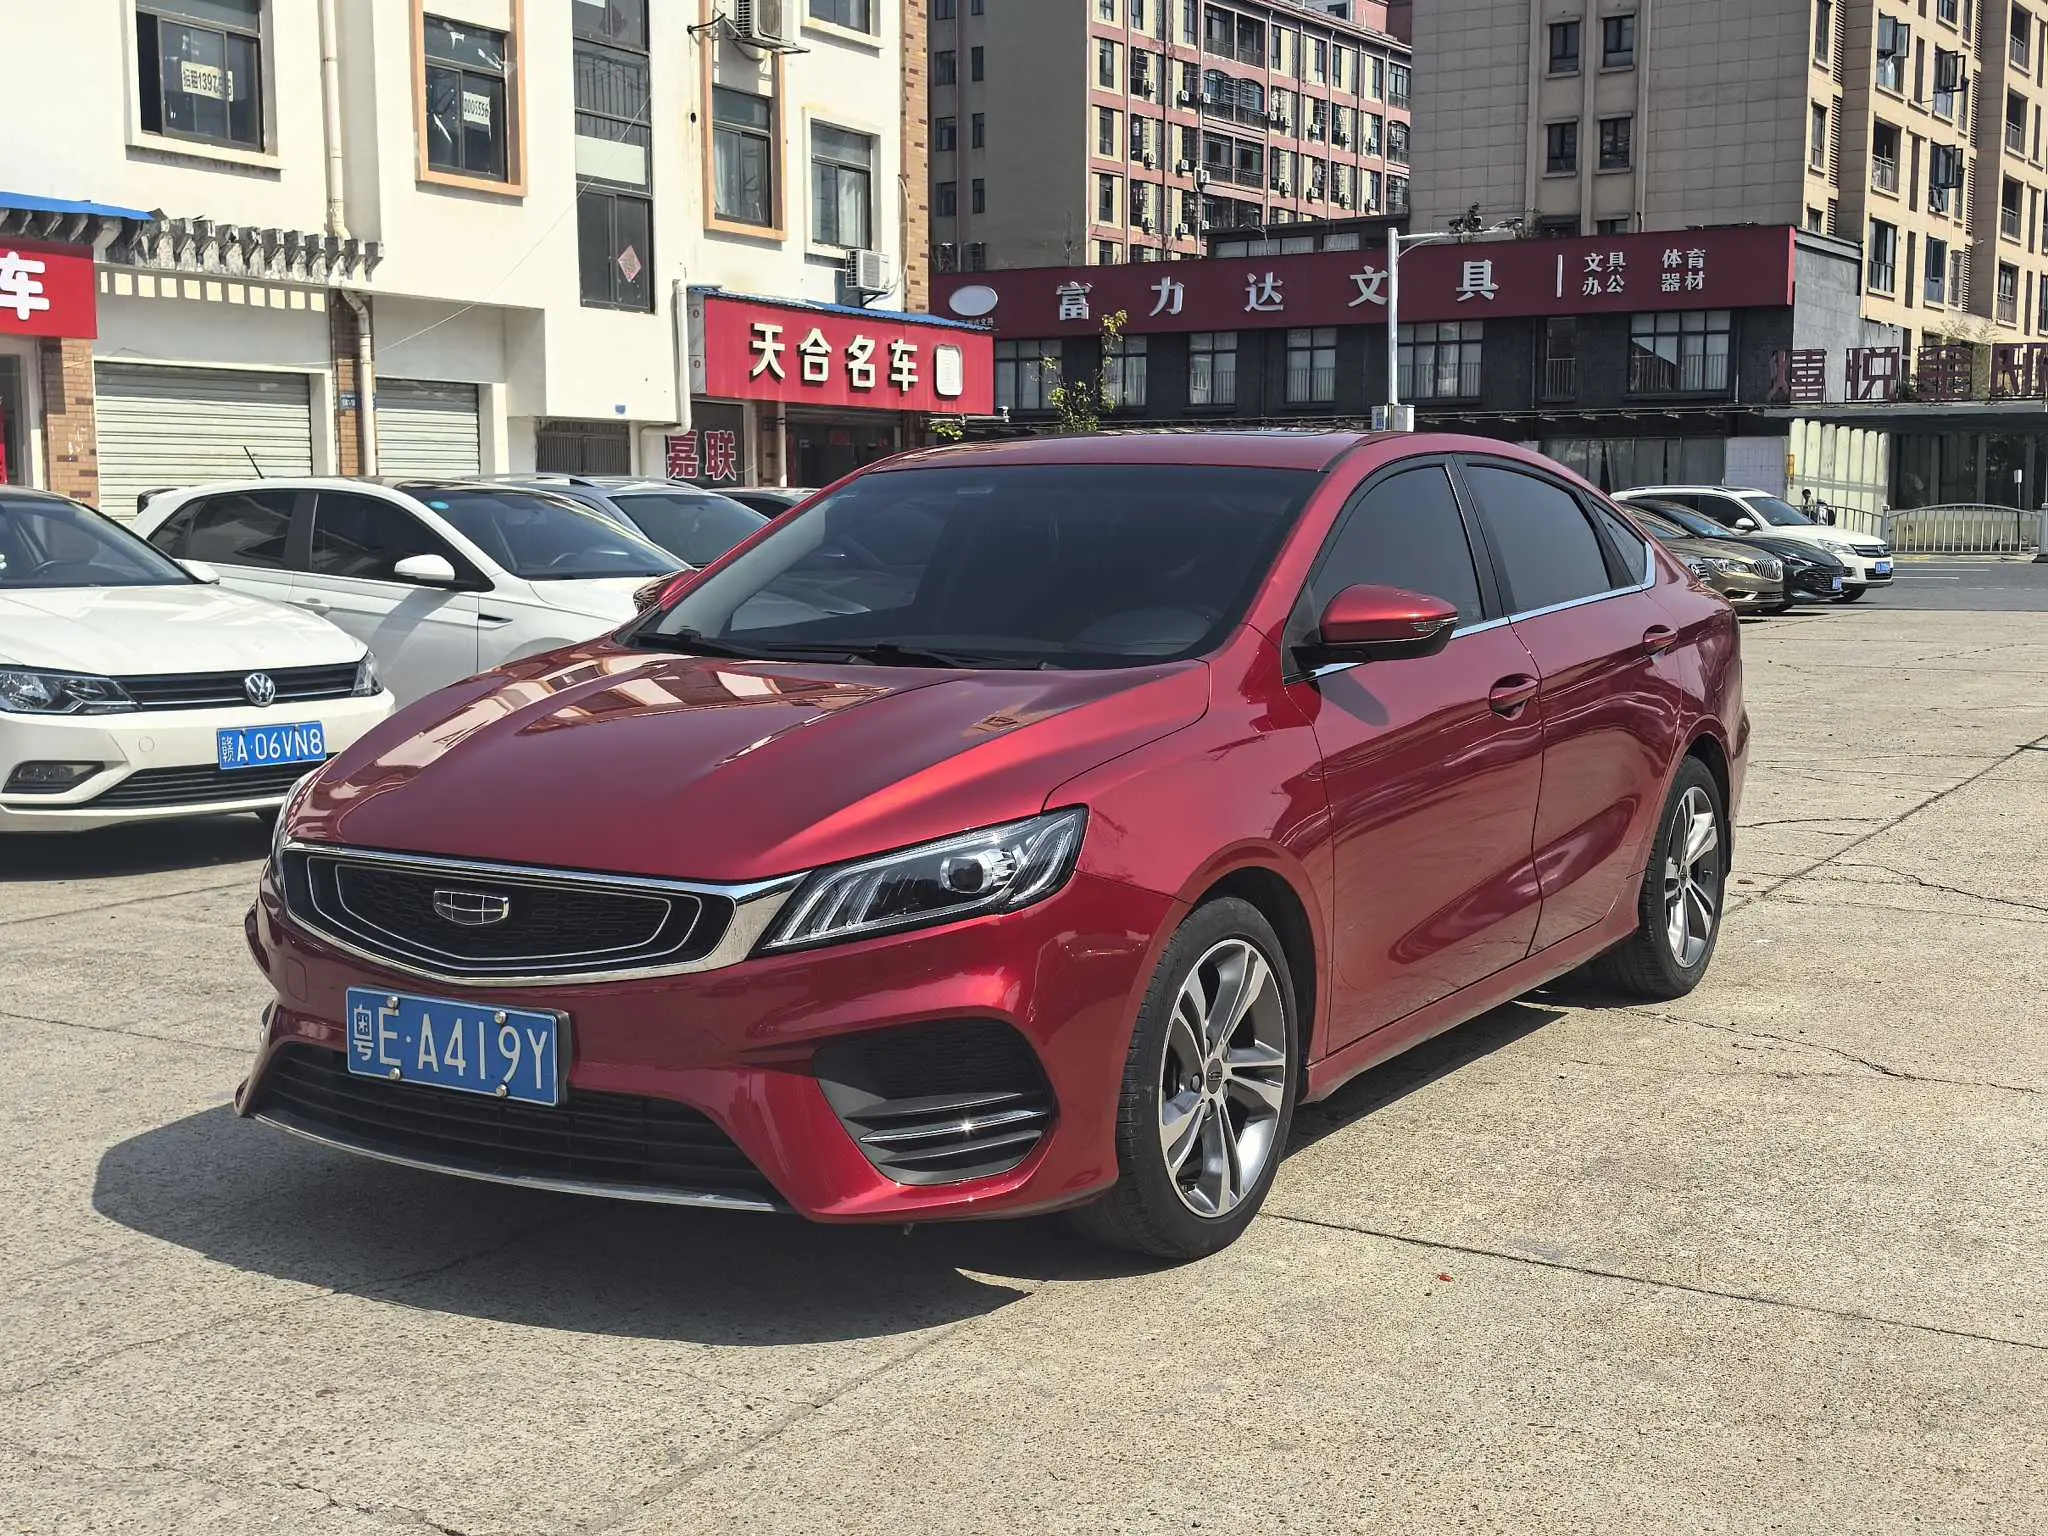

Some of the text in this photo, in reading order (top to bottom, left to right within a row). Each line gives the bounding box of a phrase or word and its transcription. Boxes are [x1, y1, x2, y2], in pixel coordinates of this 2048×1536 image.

[0, 251, 50, 321] 车
[1582, 271, 1705, 296] 办公 器材
[1583, 248, 1706, 273] 文具 体育
[1056, 259, 1499, 321] 富力达文具
[751, 322, 919, 392] 天合名车
[666, 429, 737, 481] 嘉联
